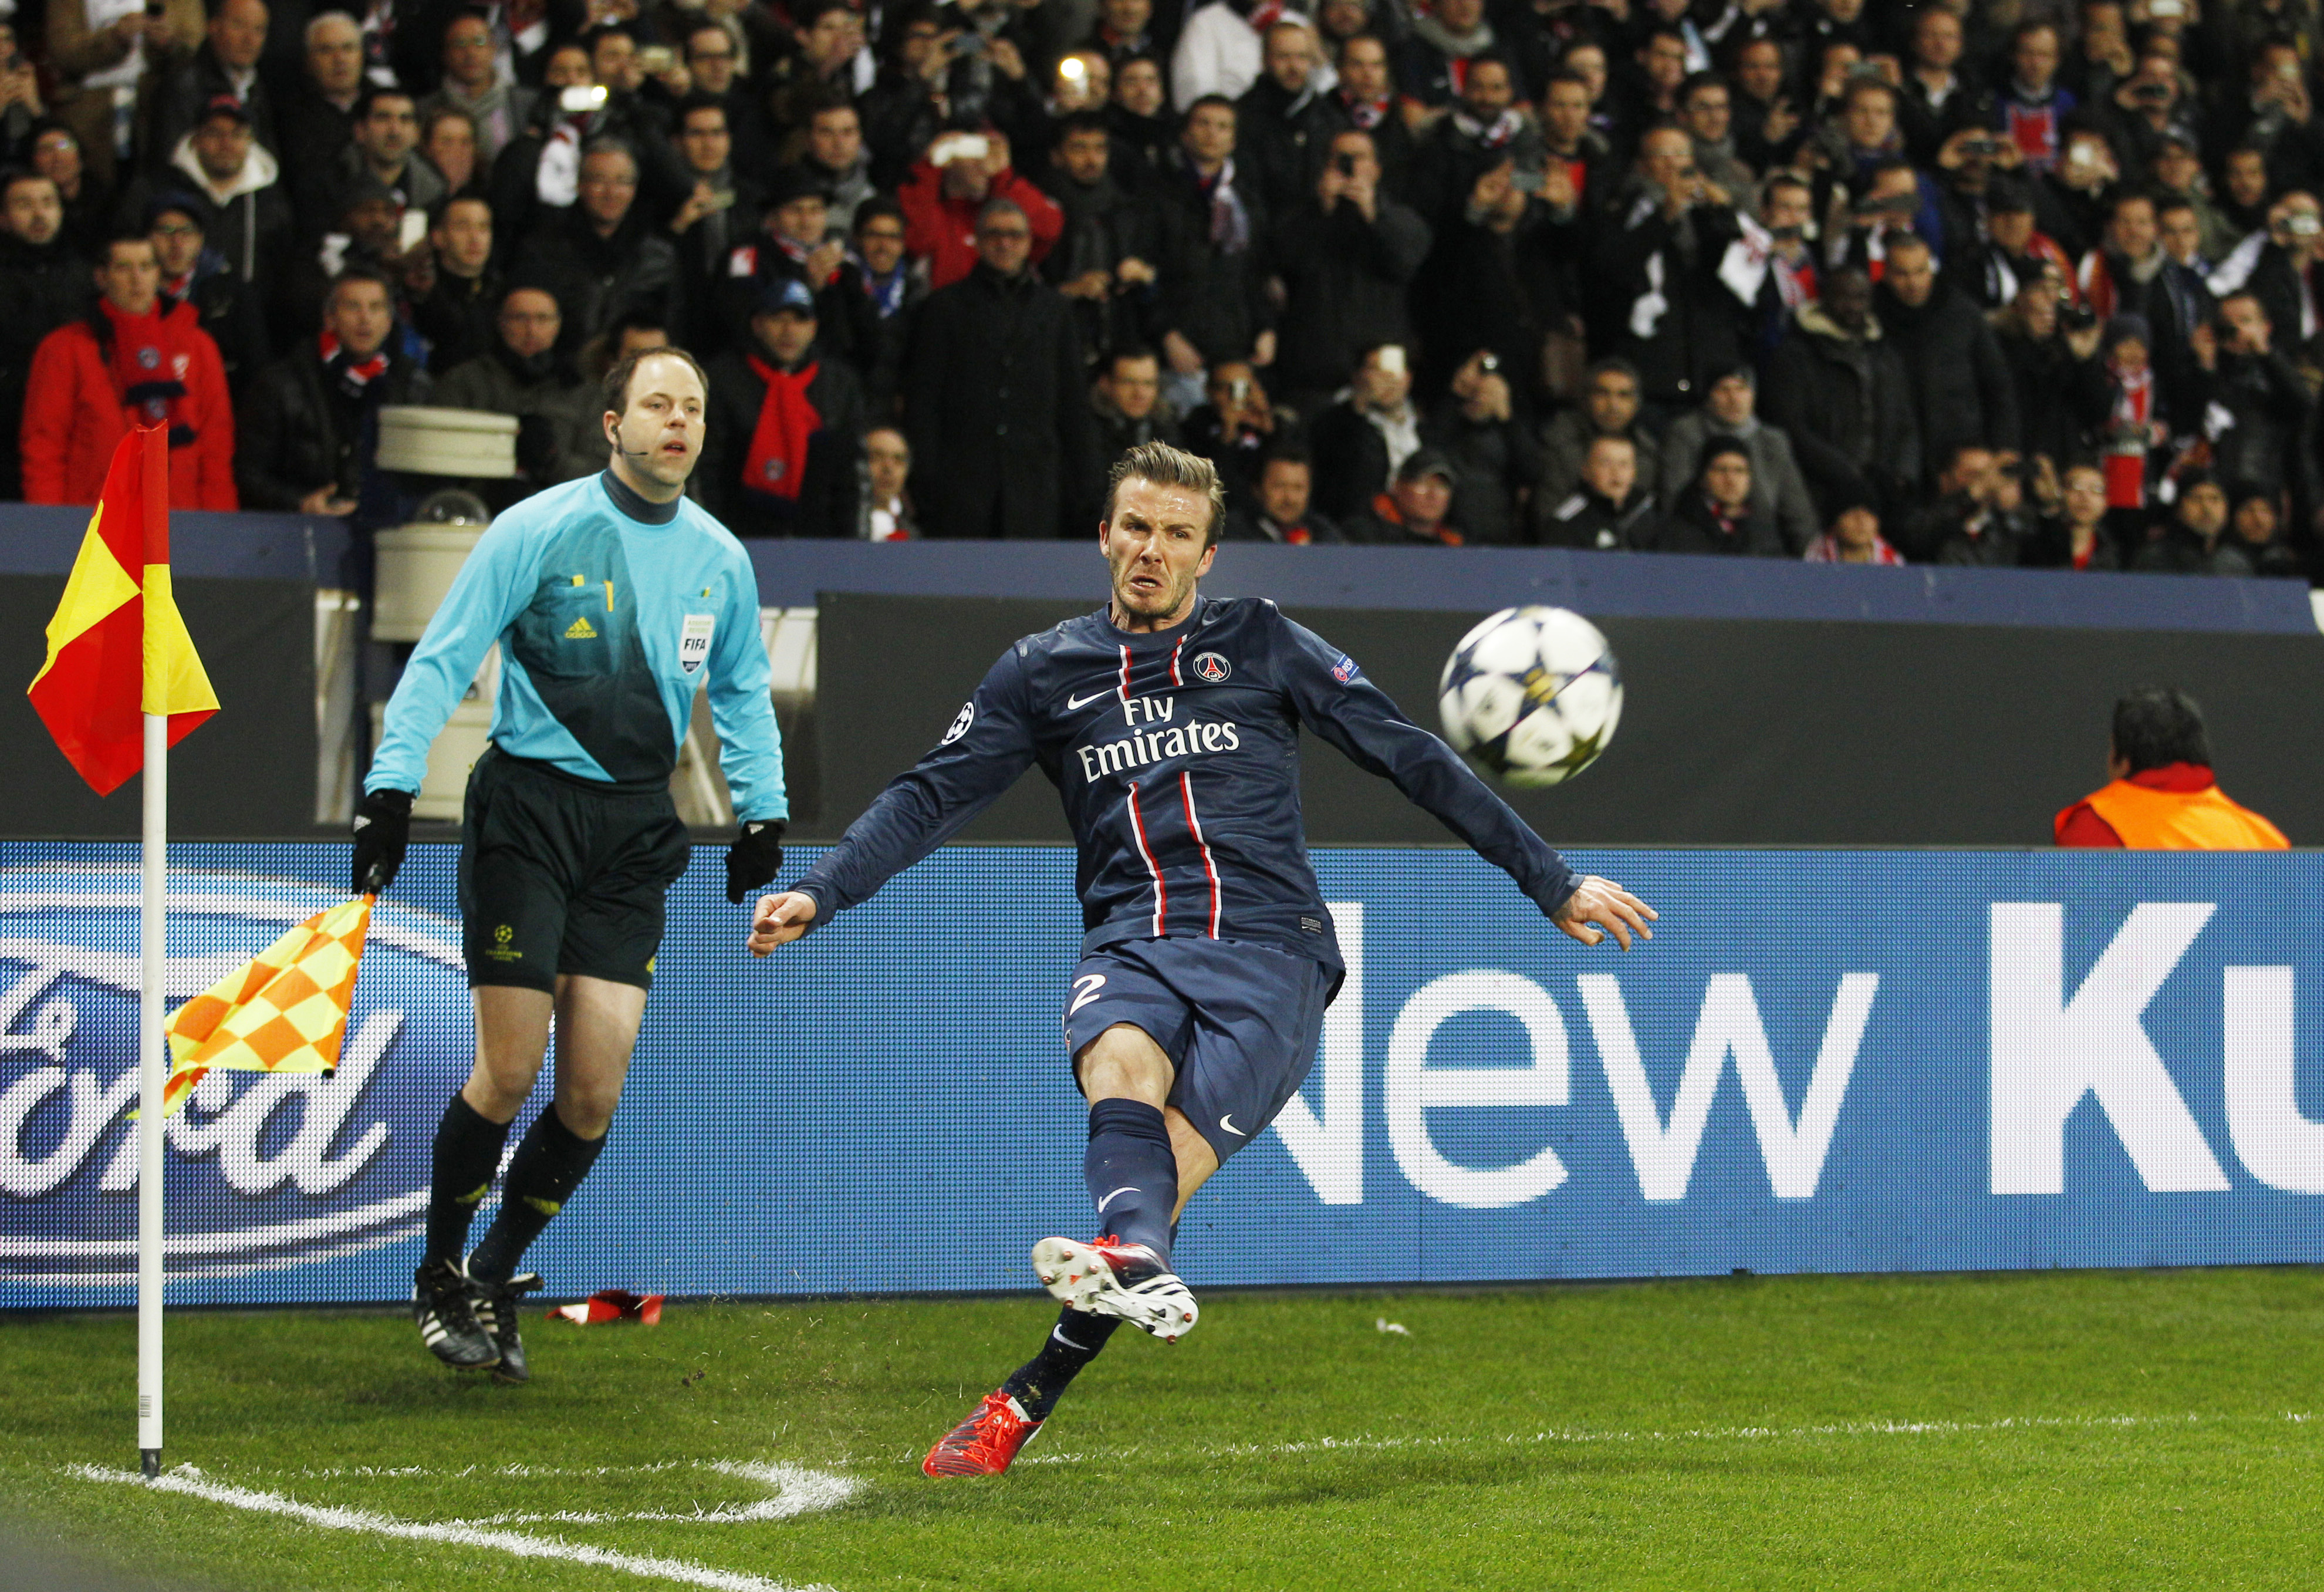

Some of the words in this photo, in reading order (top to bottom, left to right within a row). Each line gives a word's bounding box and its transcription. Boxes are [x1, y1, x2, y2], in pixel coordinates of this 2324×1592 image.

[684, 638, 706, 650] FIFA
[1122, 697, 1174, 726] Fly
[1077, 719, 1240, 784] Emirates
[1062, 973, 1107, 1028] 2
[1990, 902, 2324, 1195] Ku
